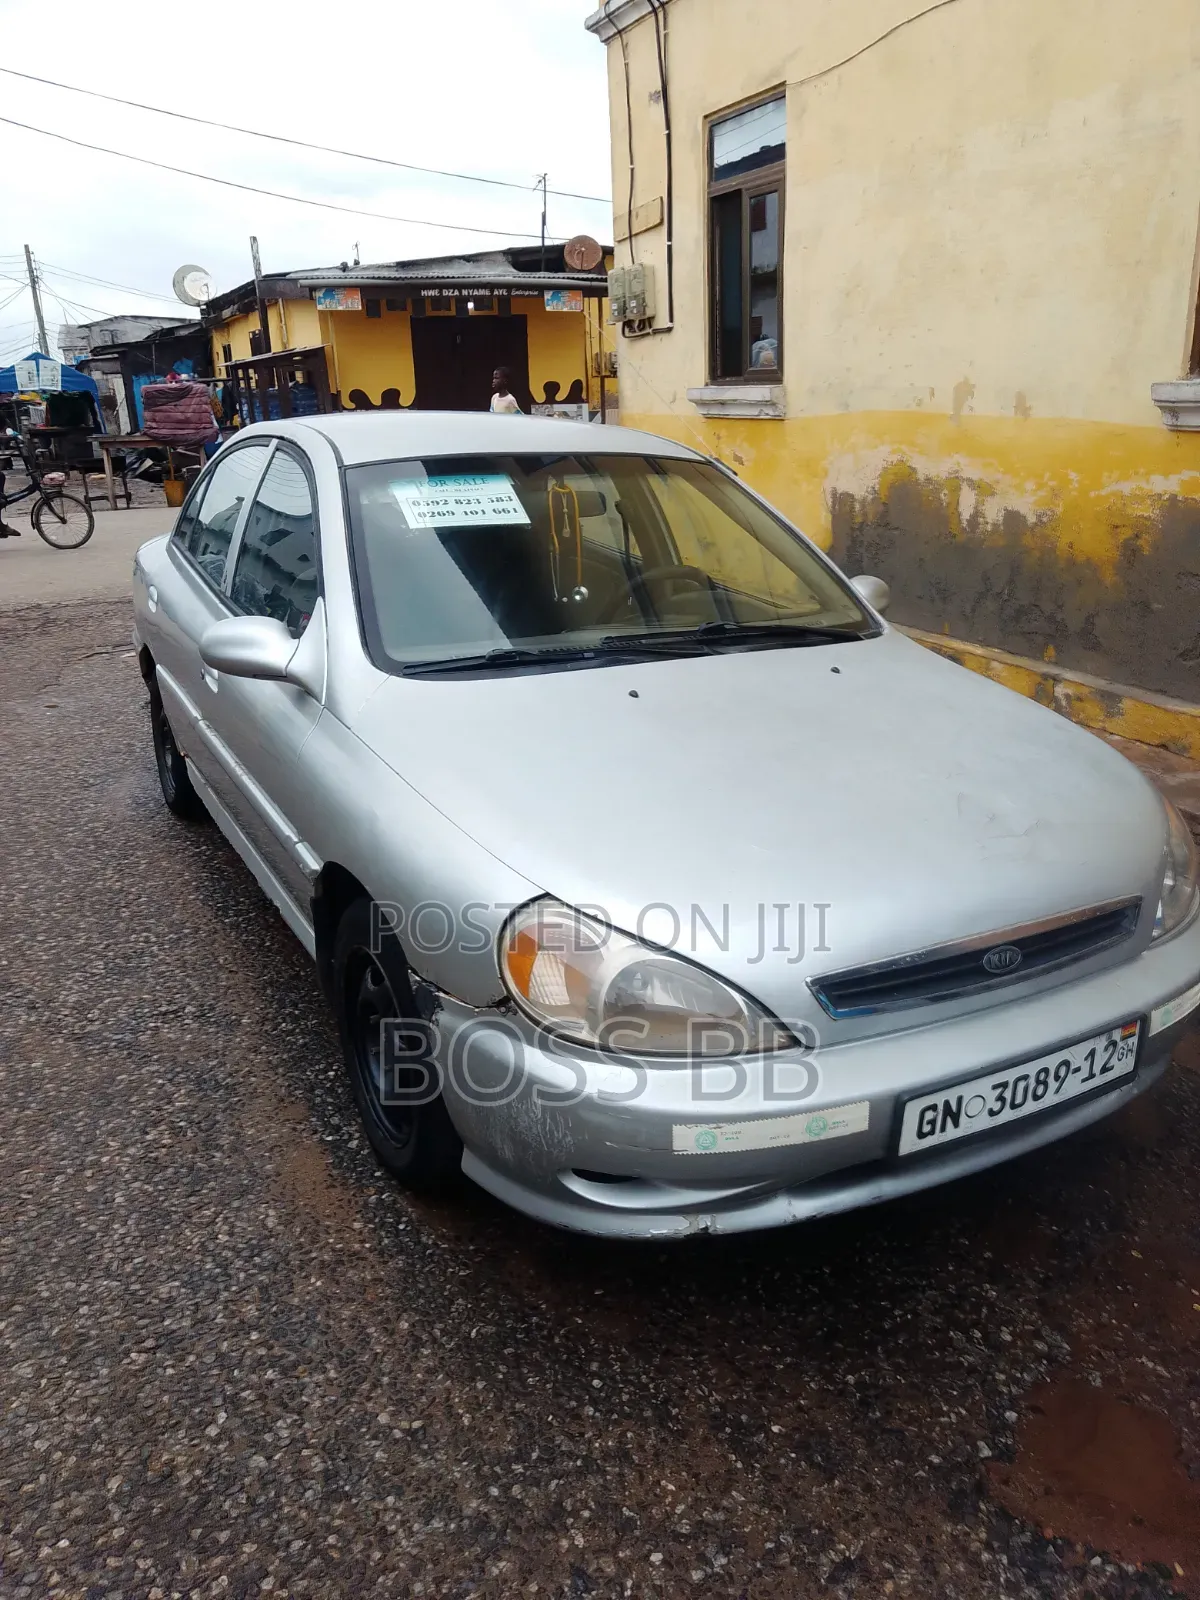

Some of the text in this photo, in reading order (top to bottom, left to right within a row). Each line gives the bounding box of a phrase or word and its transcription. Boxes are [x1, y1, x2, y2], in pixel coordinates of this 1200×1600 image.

[442, 288, 460, 296] DZA
[461, 288, 491, 296] NYAME
[510, 287, 539, 297] Enterprise
[419, 477, 490, 488] FOR SALE
[417, 509, 456, 518] 0269
[916, 1039, 1135, 1140] GN 3089-12 GH
